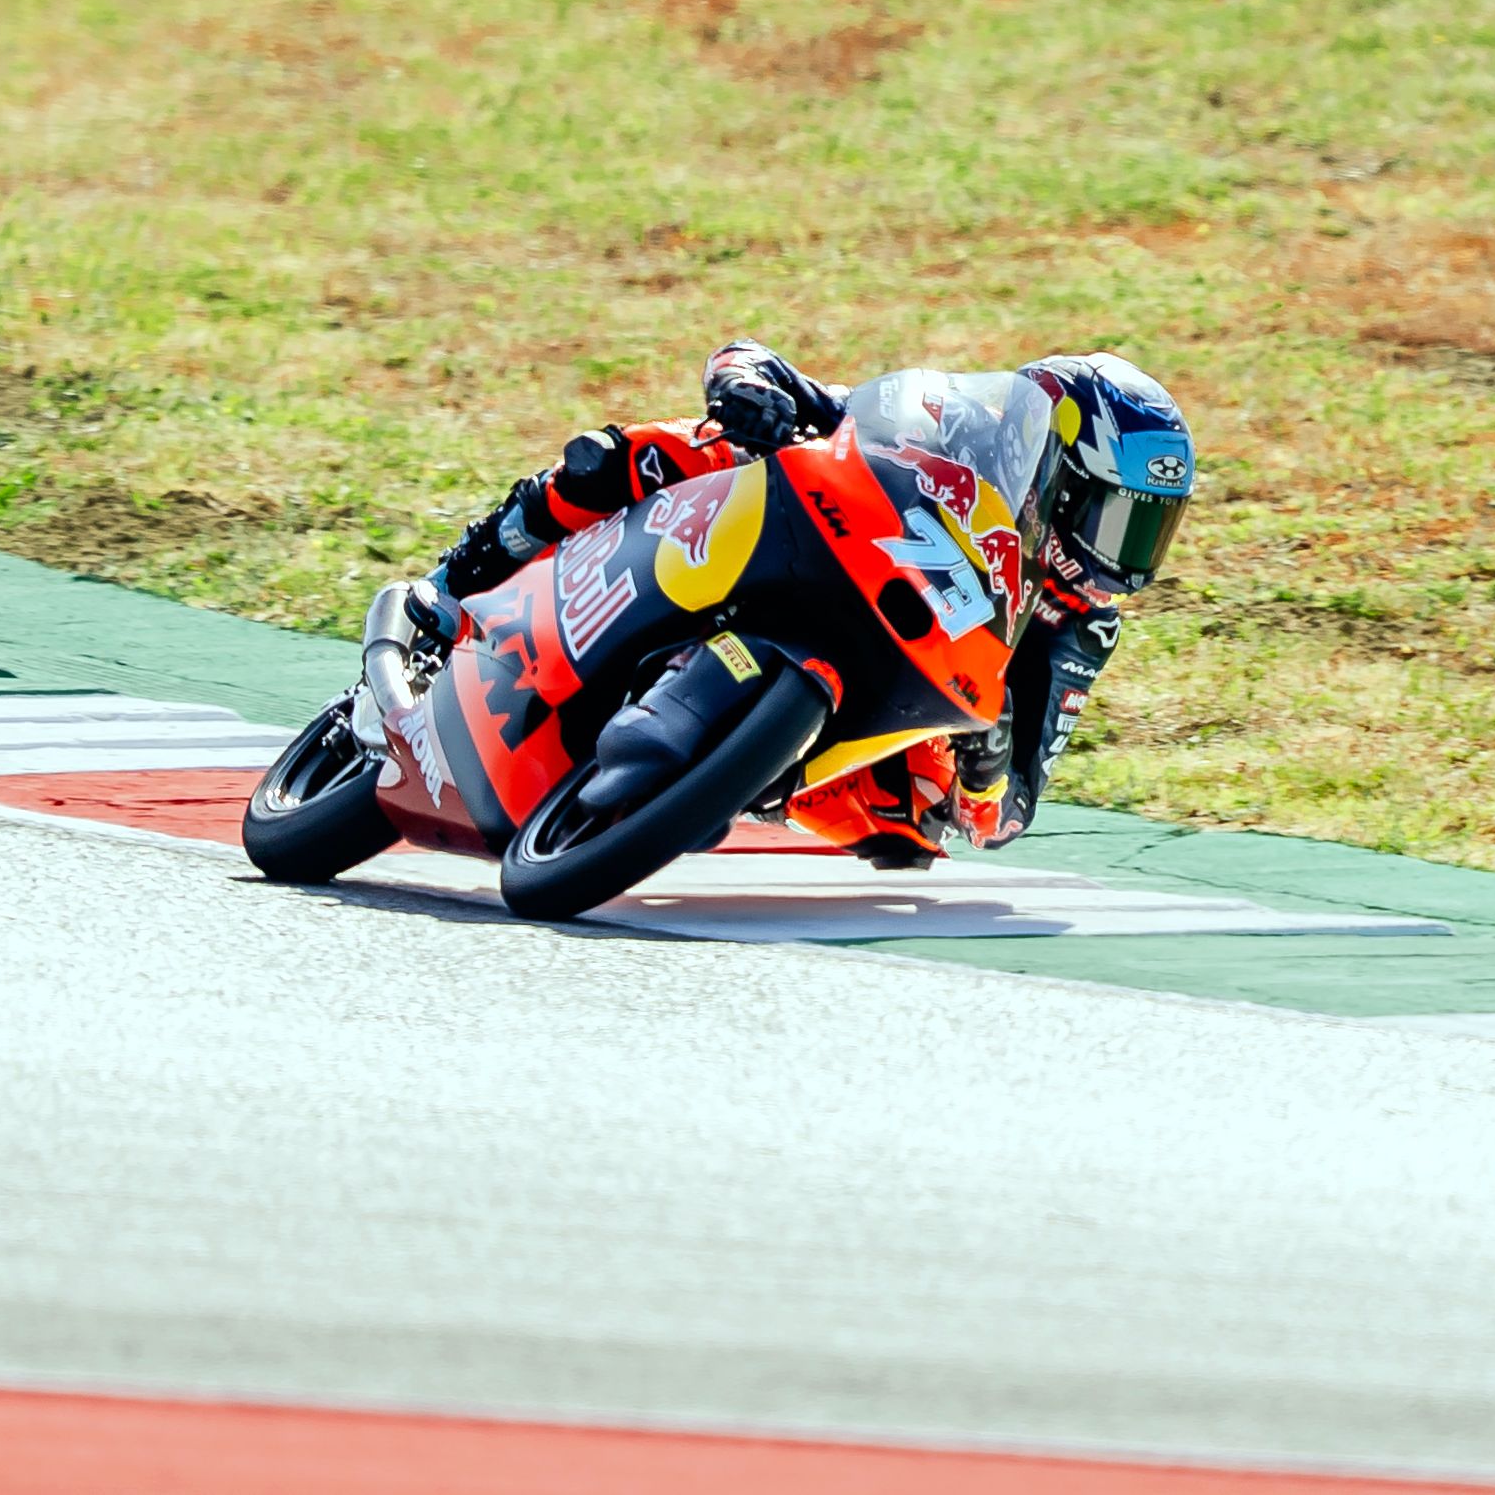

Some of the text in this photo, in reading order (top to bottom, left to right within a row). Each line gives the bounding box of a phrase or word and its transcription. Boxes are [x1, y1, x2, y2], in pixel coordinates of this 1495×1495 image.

[807, 490, 850, 539] KTM
[1117, 487, 1153, 503] GIVES
[871, 506, 996, 643] 73
[397, 707, 443, 810] MOTUL
